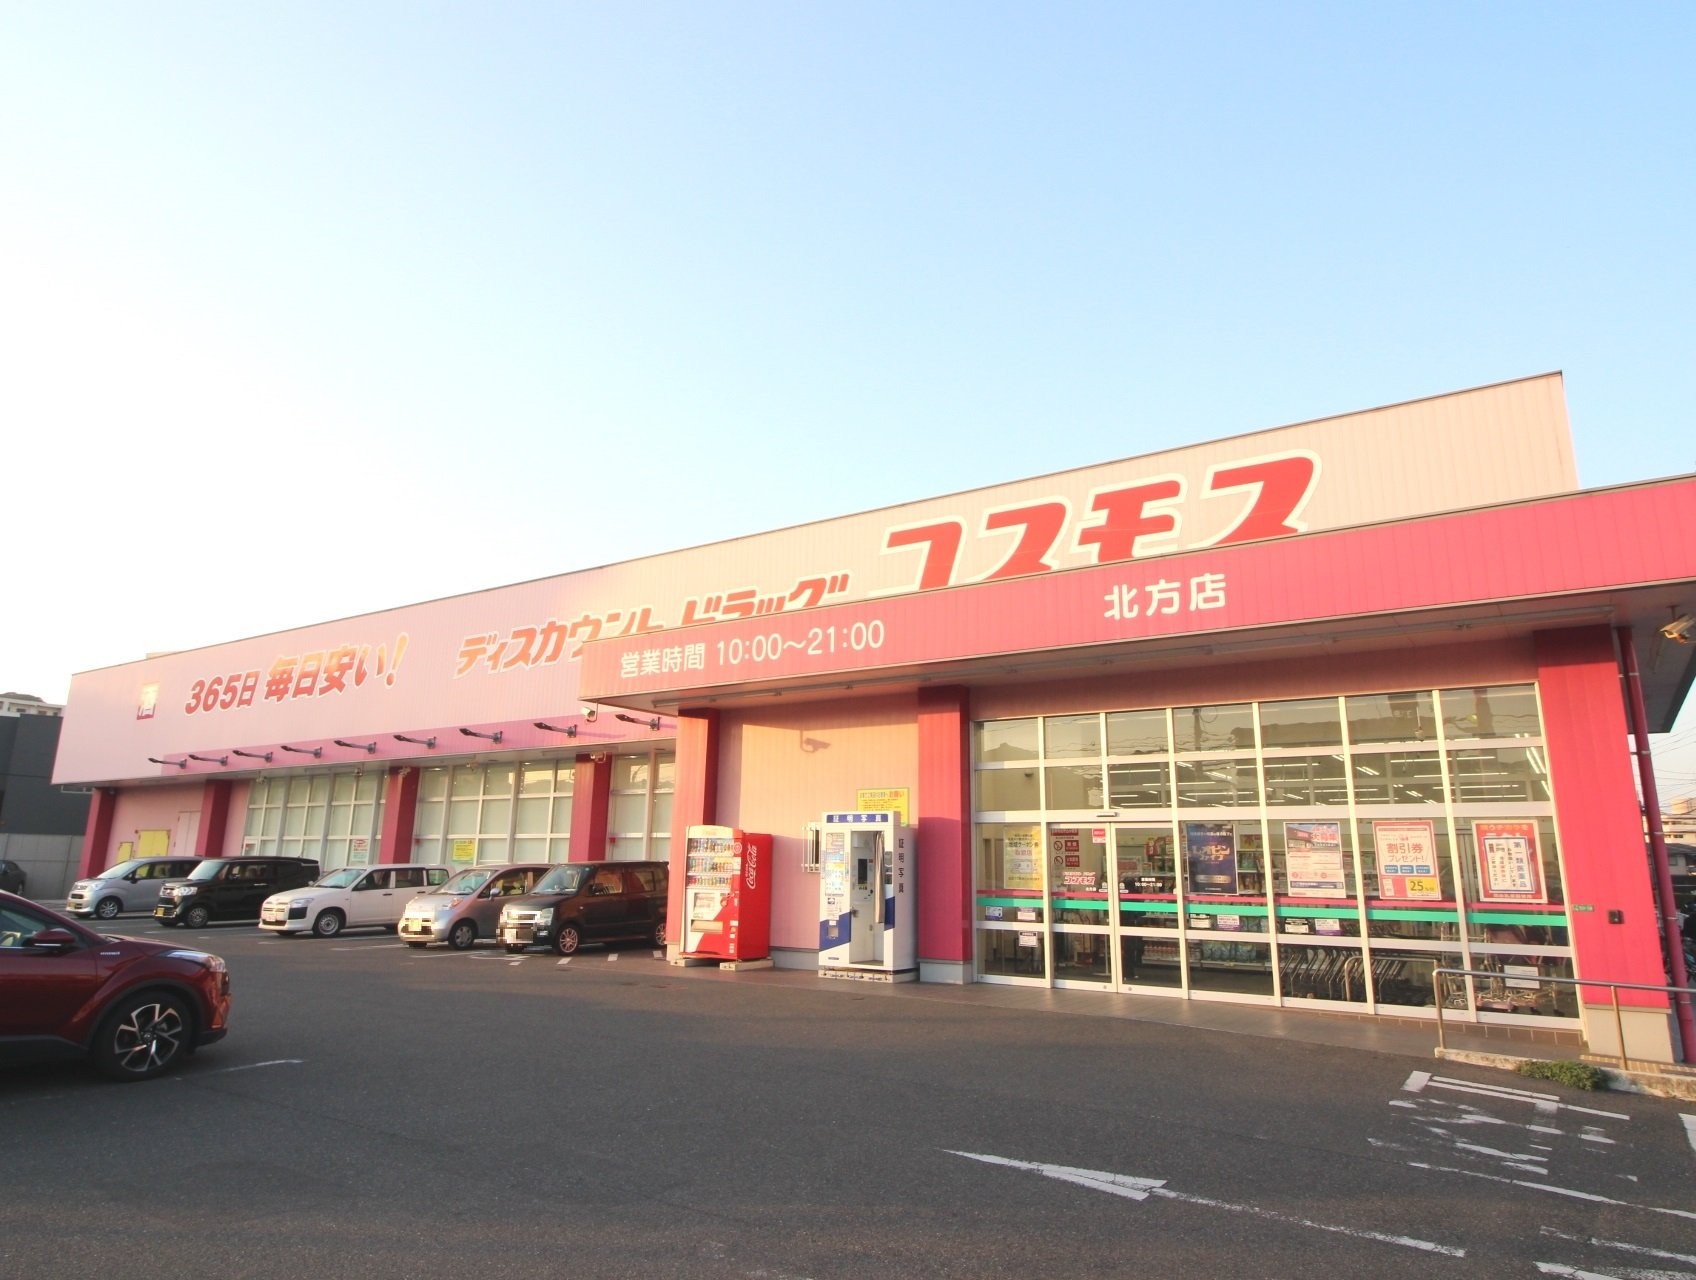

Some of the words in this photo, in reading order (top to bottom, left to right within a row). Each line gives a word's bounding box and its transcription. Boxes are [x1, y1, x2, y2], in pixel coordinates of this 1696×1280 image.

[880, 451, 1318, 591] コスモス
[1103, 572, 1226, 621] 北方店
[620, 643, 705, 679] 営業時間
[185, 670, 261, 714] 365日
[1386, 843, 1424, 854] 割引券
[1410, 880, 1424, 891] 25
